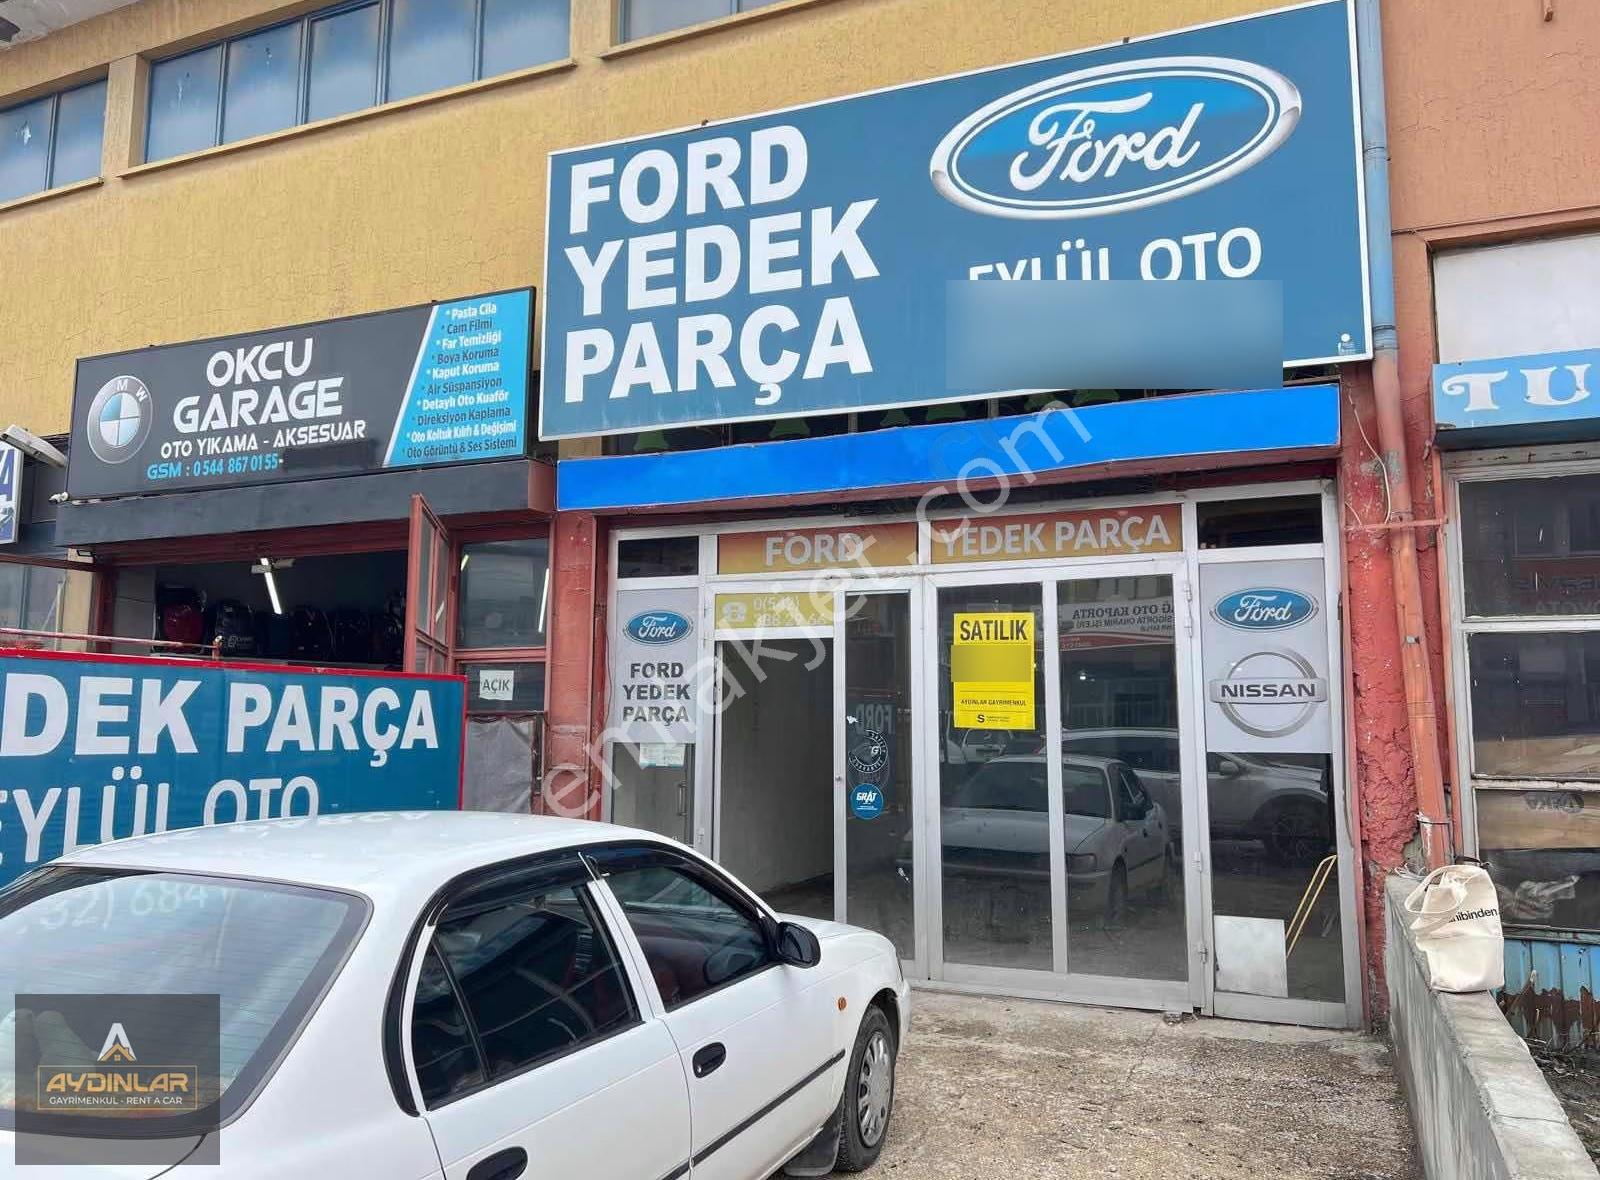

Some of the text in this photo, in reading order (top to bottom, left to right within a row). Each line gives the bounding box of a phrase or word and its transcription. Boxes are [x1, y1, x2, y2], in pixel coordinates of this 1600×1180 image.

[1009, 91, 1206, 192] Ford
[569, 125, 808, 234] FORD
[563, 198, 881, 316] YEDEK
[1140, 227, 1262, 281] OTO
[451, 302, 497, 320] Pasta Cila
[447, 318, 492, 335] Cam Filmi
[442, 329, 502, 350] Far Temizliği
[564, 295, 874, 406] PARÇA
[206, 337, 313, 388] OKCU
[437, 347, 499, 365] Boya Koruma
[432, 361, 499, 380] Kaput Koruma
[427, 377, 502, 396] Air Süspansiyon
[1441, 363, 1591, 412] TU
[173, 376, 345, 434] GARAGE
[422, 389, 509, 411] Detaylı Oto Kuaför
[417, 407, 511, 427] Direksiyon Kaplama
[160, 441, 192, 459] OTO
[197, 434, 258, 456] YIKAMA
[273, 420, 366, 448] AKSESUAR
[407, 436, 517, 459] Oto Görüntü & Ses Sistemi
[411, 430, 426, 443] Oto
[147, 462, 181, 480] GSM
[202, 458, 224, 476] 544
[228, 456, 248, 474] 867
[941, 513, 1171, 559] YEDEK PARÇA
[765, 532, 864, 567] FORD
[1234, 595, 1291, 624] Ford
[637, 615, 677, 639] Ford
[960, 620, 1028, 641] SATILIK
[629, 662, 684, 679] FORD
[482, 679, 510, 694] AÇIK
[622, 684, 691, 700] YEDEK
[1220, 682, 1316, 699] NISSAN
[226, 682, 439, 768] PARÇA
[622, 706, 690, 727] PARÇA
[0, 765, 319, 862] YLÜL OTO
